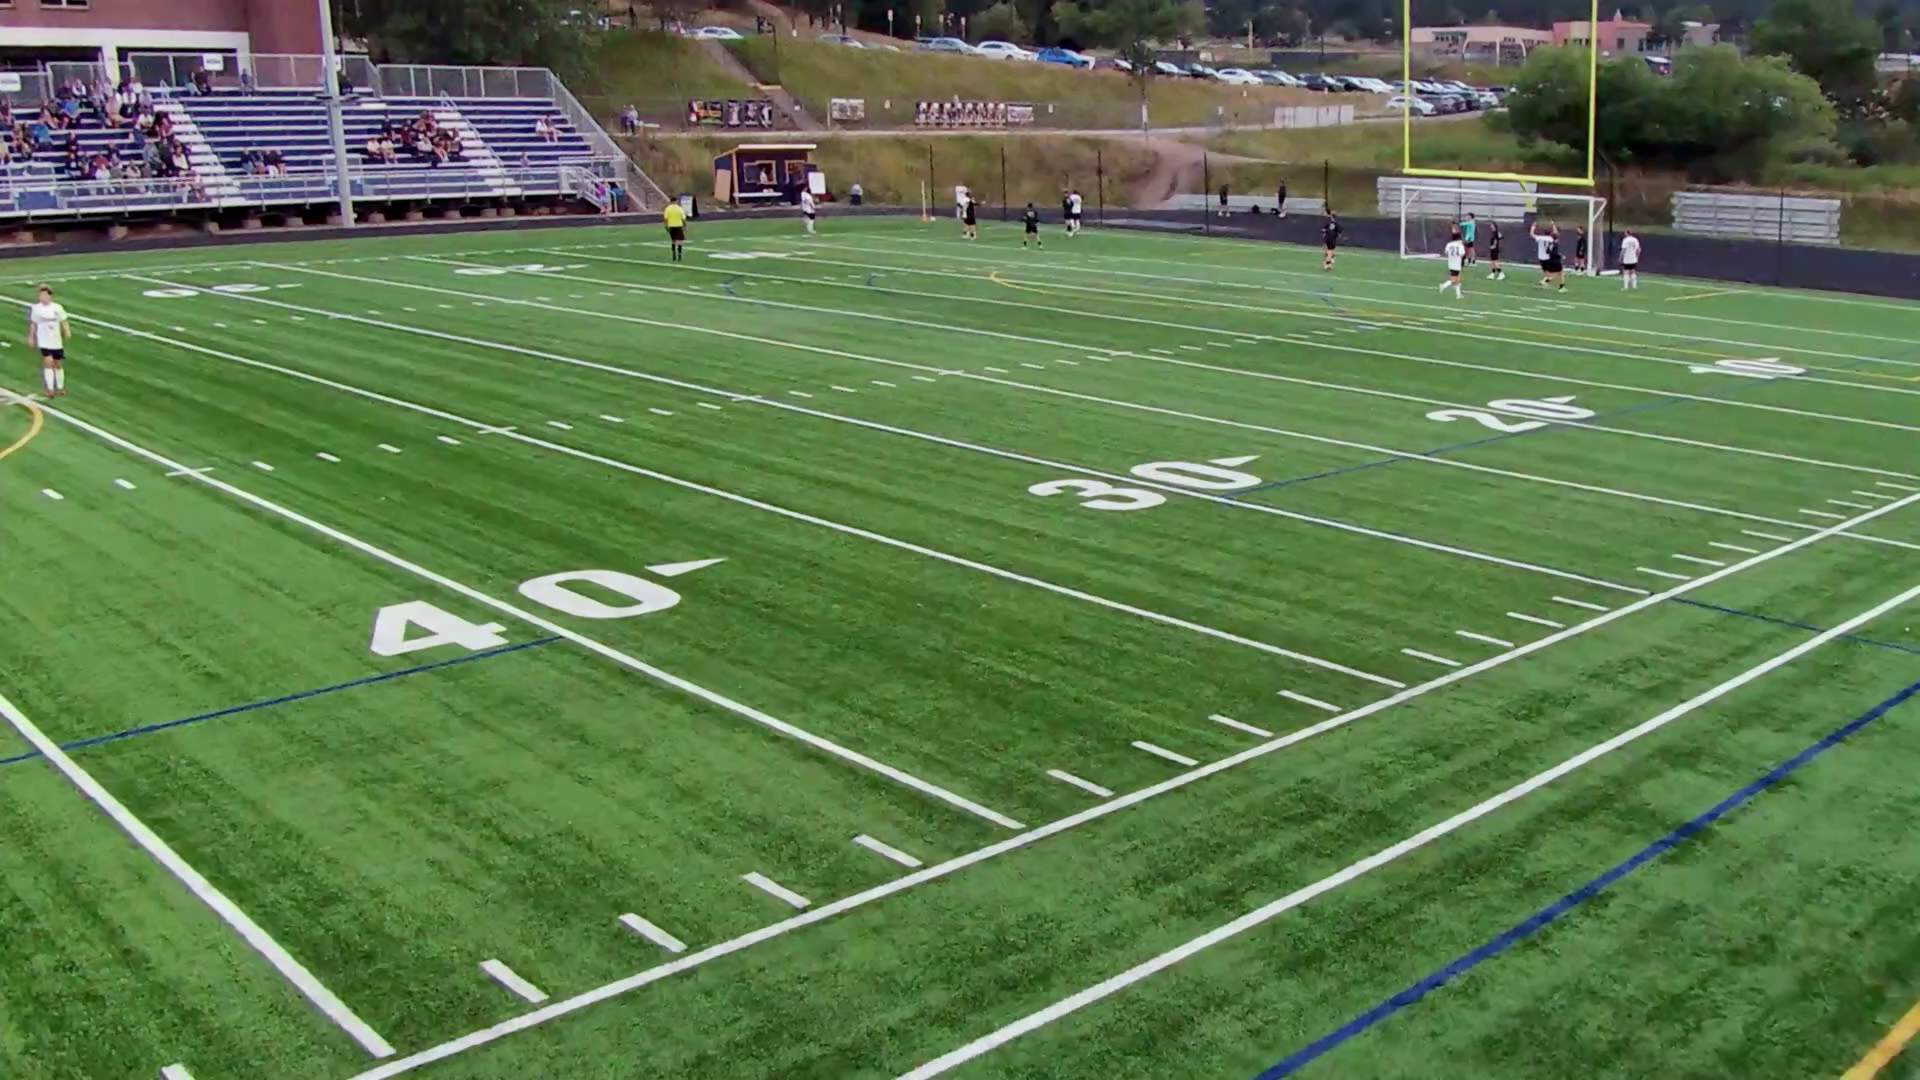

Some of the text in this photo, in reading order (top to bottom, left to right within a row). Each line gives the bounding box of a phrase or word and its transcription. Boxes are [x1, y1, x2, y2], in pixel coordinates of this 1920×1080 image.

[1425, 399, 1596, 433] 20
[1028, 461, 1262, 510] 30
[370, 569, 682, 657] 40
